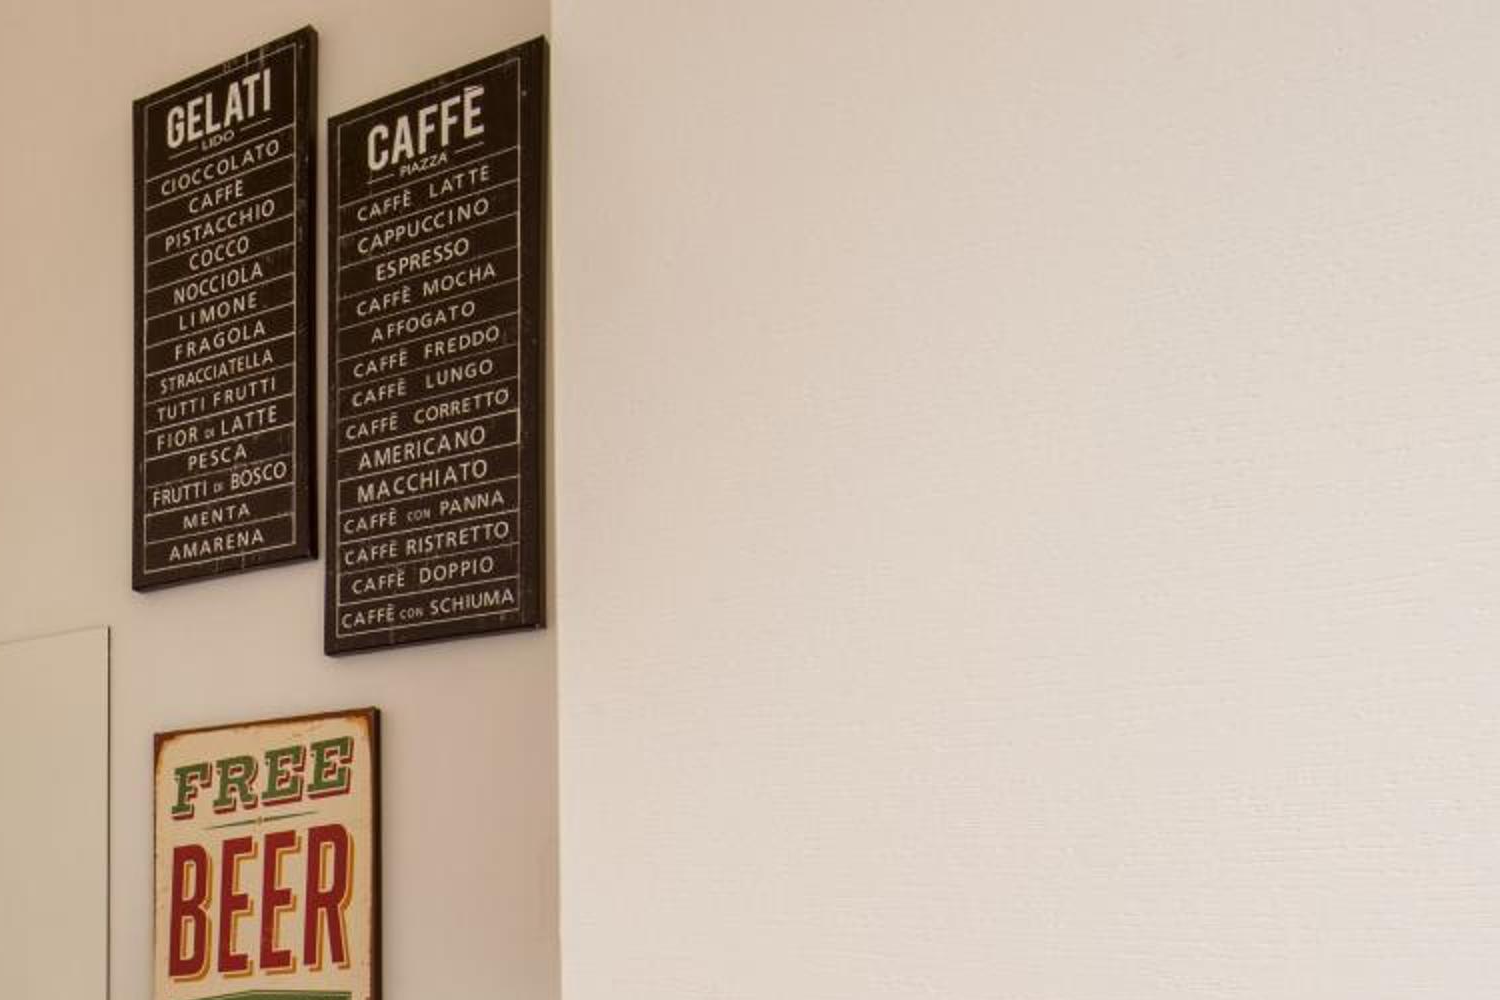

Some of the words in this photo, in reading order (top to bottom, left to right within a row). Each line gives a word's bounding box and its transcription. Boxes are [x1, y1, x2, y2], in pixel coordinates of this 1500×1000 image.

[167, 69, 271, 149] GELATI
[201, 130, 235, 151] LIDO
[161, 139, 279, 196] CIOCCOLATO
[399, 151, 448, 178] PIAZZA
[357, 189, 412, 221] CAFFÈ
[429, 165, 490, 199] LATTE
[165, 199, 275, 252] PISTACCHIO
[357, 198, 489, 254] CAPPUCCINO
[188, 236, 249, 270] COCCO
[375, 237, 469, 281] ESPRESSO
[173, 262, 263, 305] NOCCIOLA
[356, 285, 411, 317] CAFFÈ
[423, 262, 497, 297] MOCHA
[179, 291, 258, 331] LIMONE
[371, 301, 475, 343] AFFOGATO
[174, 320, 266, 361] FRAGOLA
[353, 348, 408, 378] CAFFÈ
[424, 325, 499, 359] FREDDO
[160, 349, 273, 395] STRACCIATELLA
[352, 377, 407, 408] CAFFÈ
[425, 359, 493, 390] LUNGO
[157, 396, 205, 423] TUTTI
[213, 376, 276, 407] FRUTTI
[345, 412, 398, 440] CAFFÈ
[413, 387, 510, 424] CORRETTO
[156, 427, 198, 452] FIOR
[221, 405, 277, 435] LATTE
[358, 425, 485, 471] AMERICANO
[187, 443, 247, 471] PESCA
[153, 481, 207, 508] FRUTTI
[231, 461, 287, 490] BOSCO
[357, 459, 488, 503] MACCHIATO
[183, 503, 250, 529] MENTA
[343, 508, 397, 535] CAFFÈ
[406, 508, 431, 523] CON
[439, 489, 505, 516] PANNA
[169, 528, 264, 561] AMARENA
[406, 521, 509, 556] RISTRETTO
[351, 569, 405, 595] CAFFÈ
[419, 556, 494, 584] DOPPIO
[341, 603, 395, 629] CAFFÈ
[399, 607, 424, 619] CON
[429, 588, 515, 616] SCHIUMA
[171, 736, 354, 821] FREE
[168, 823, 355, 982] BEER
